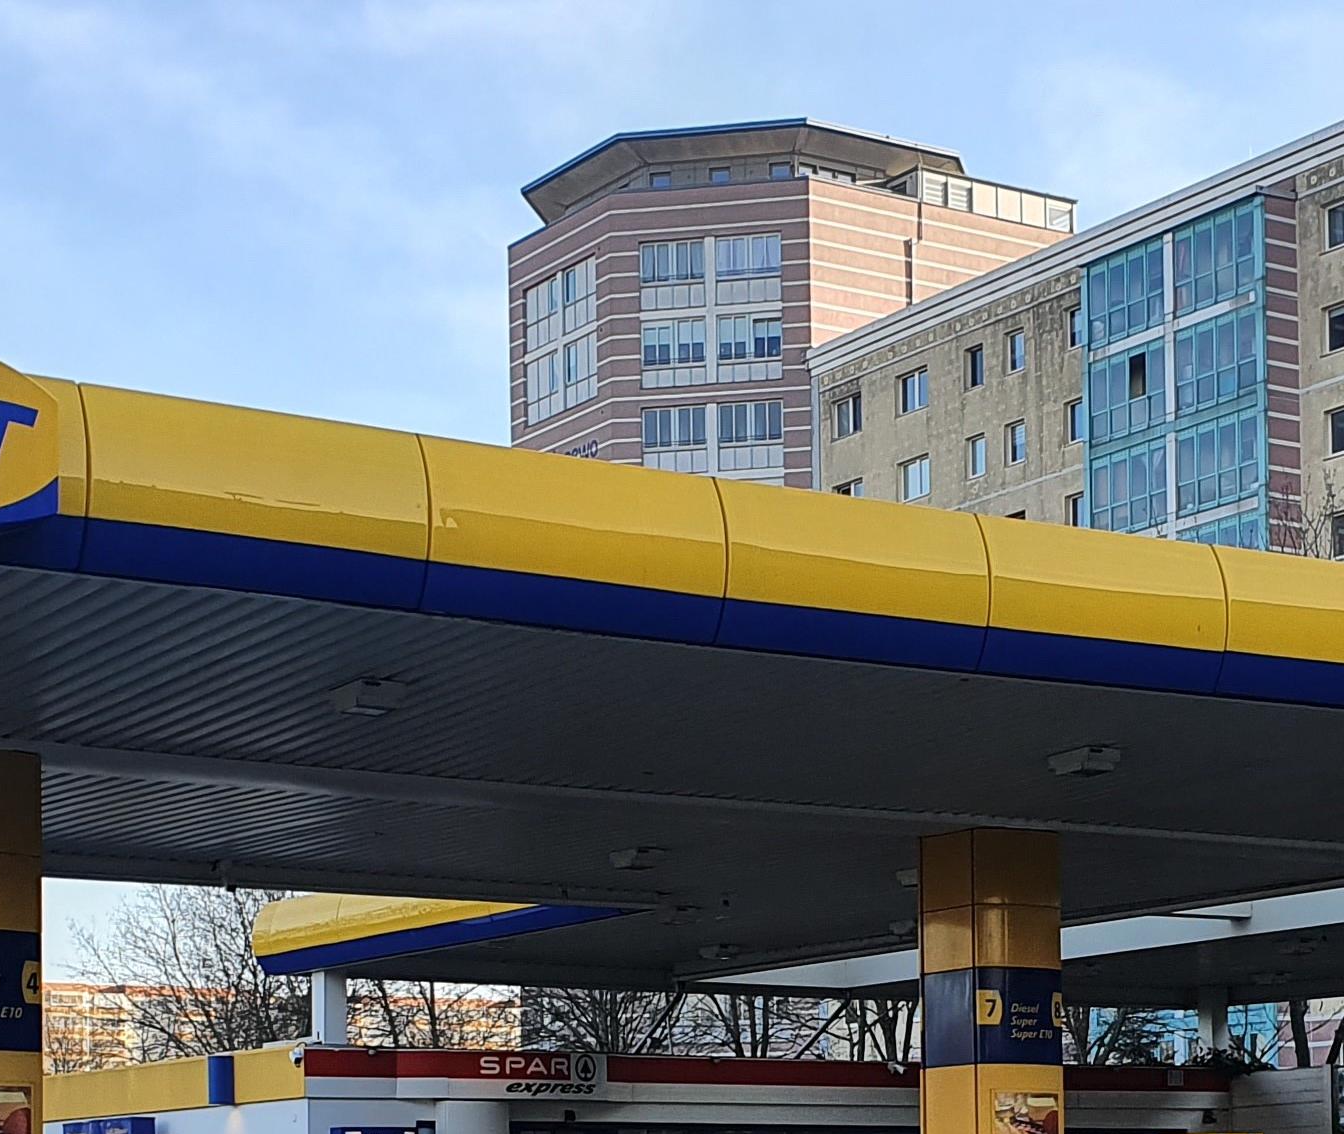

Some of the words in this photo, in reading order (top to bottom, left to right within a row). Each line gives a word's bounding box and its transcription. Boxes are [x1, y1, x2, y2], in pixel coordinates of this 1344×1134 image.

[26, 972, 39, 995] 4
[0, 1006, 23, 1019] E10
[985, 999, 997, 1018] 7
[1010, 1003, 1040, 1014] Diesel
[1010, 1015, 1038, 1028] Super
[1010, 1028, 1038, 1041] Super
[1039, 1029, 1053, 1040] E10
[479, 1056, 569, 1076] SPAR
[505, 1081, 596, 1097] express
